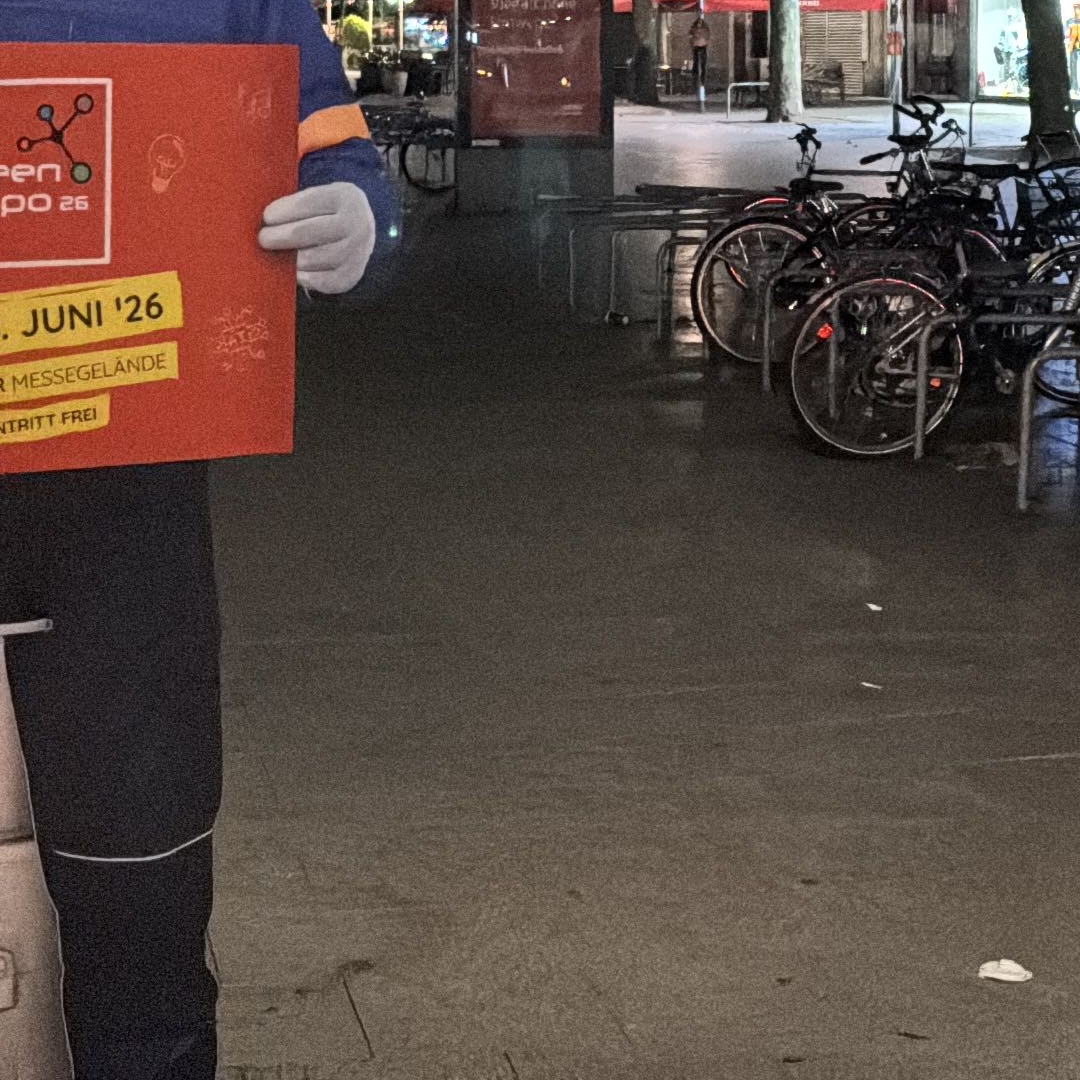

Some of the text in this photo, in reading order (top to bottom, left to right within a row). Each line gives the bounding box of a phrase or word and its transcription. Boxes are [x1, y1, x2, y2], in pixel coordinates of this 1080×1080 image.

[59, 195, 89, 212] 26
[22, 300, 104, 339] JUNI
[115, 292, 164, 323] '26
[12, 352, 168, 393] MESSEGELÄNDE
[60, 407, 98, 427] FREI
